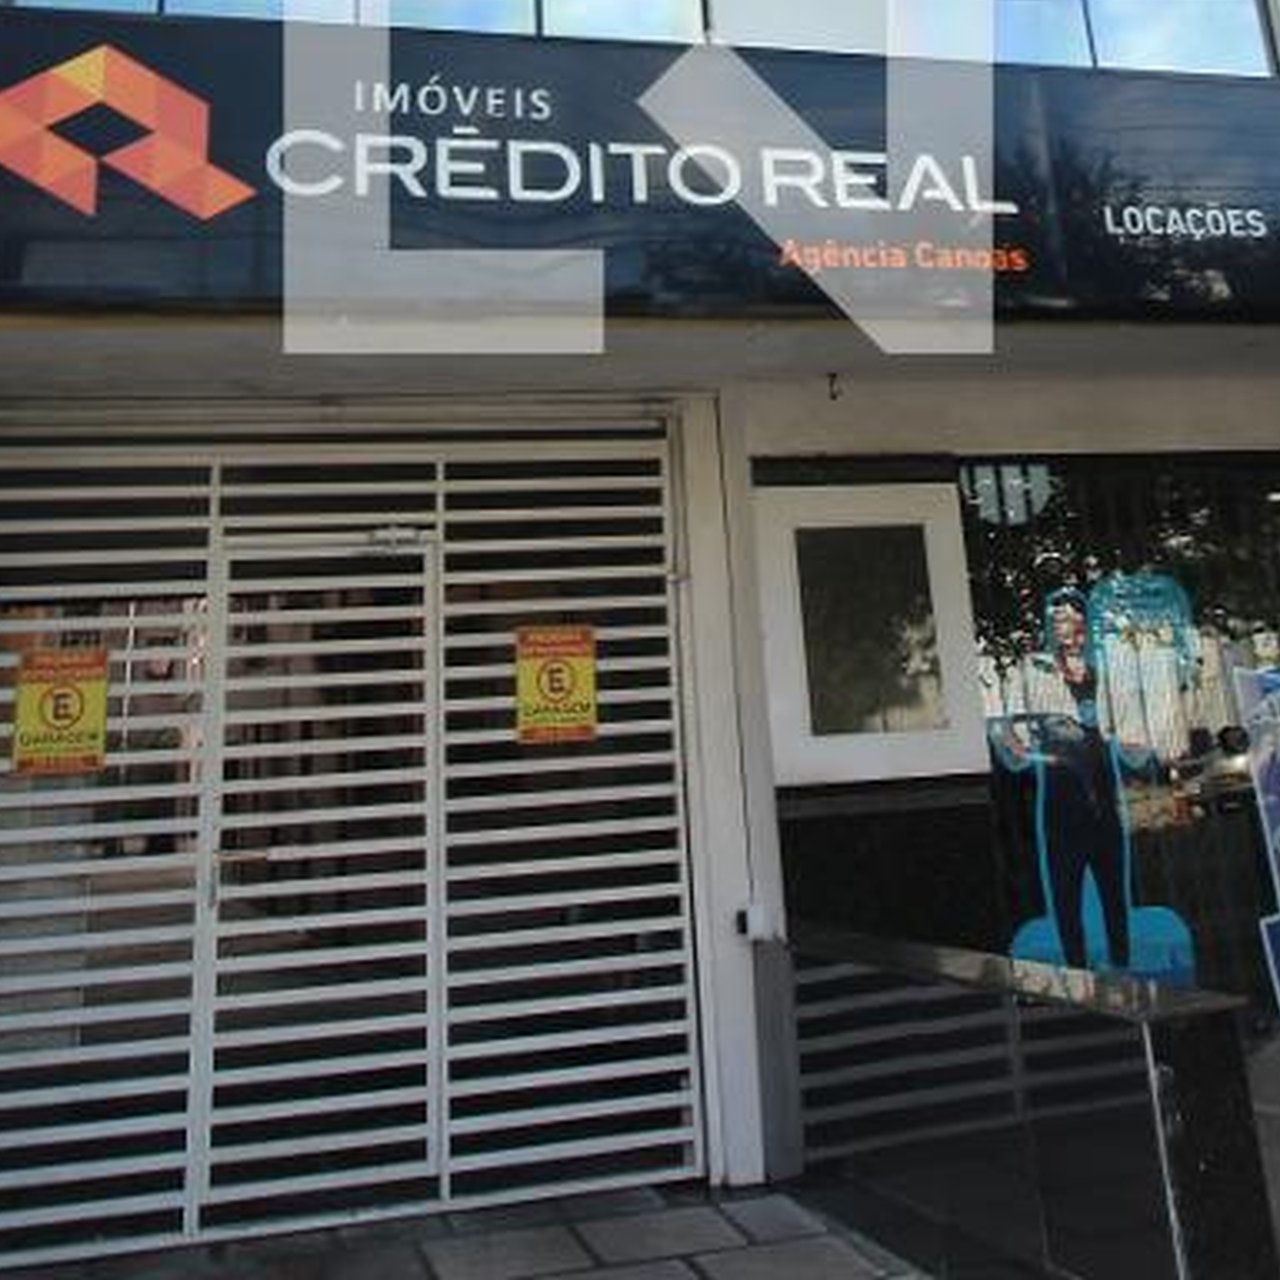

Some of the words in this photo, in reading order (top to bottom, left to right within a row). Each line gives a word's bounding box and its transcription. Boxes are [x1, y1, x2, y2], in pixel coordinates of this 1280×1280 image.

[352, 74, 553, 121] IMÓVEIS
[266, 126, 741, 206] CRÉDITO
[763, 148, 1018, 216] REAL
[1104, 202, 1267, 241] LOCAÇÕES
[779, 239, 907, 276] Agência
[912, 241, 1030, 273] Canoas
